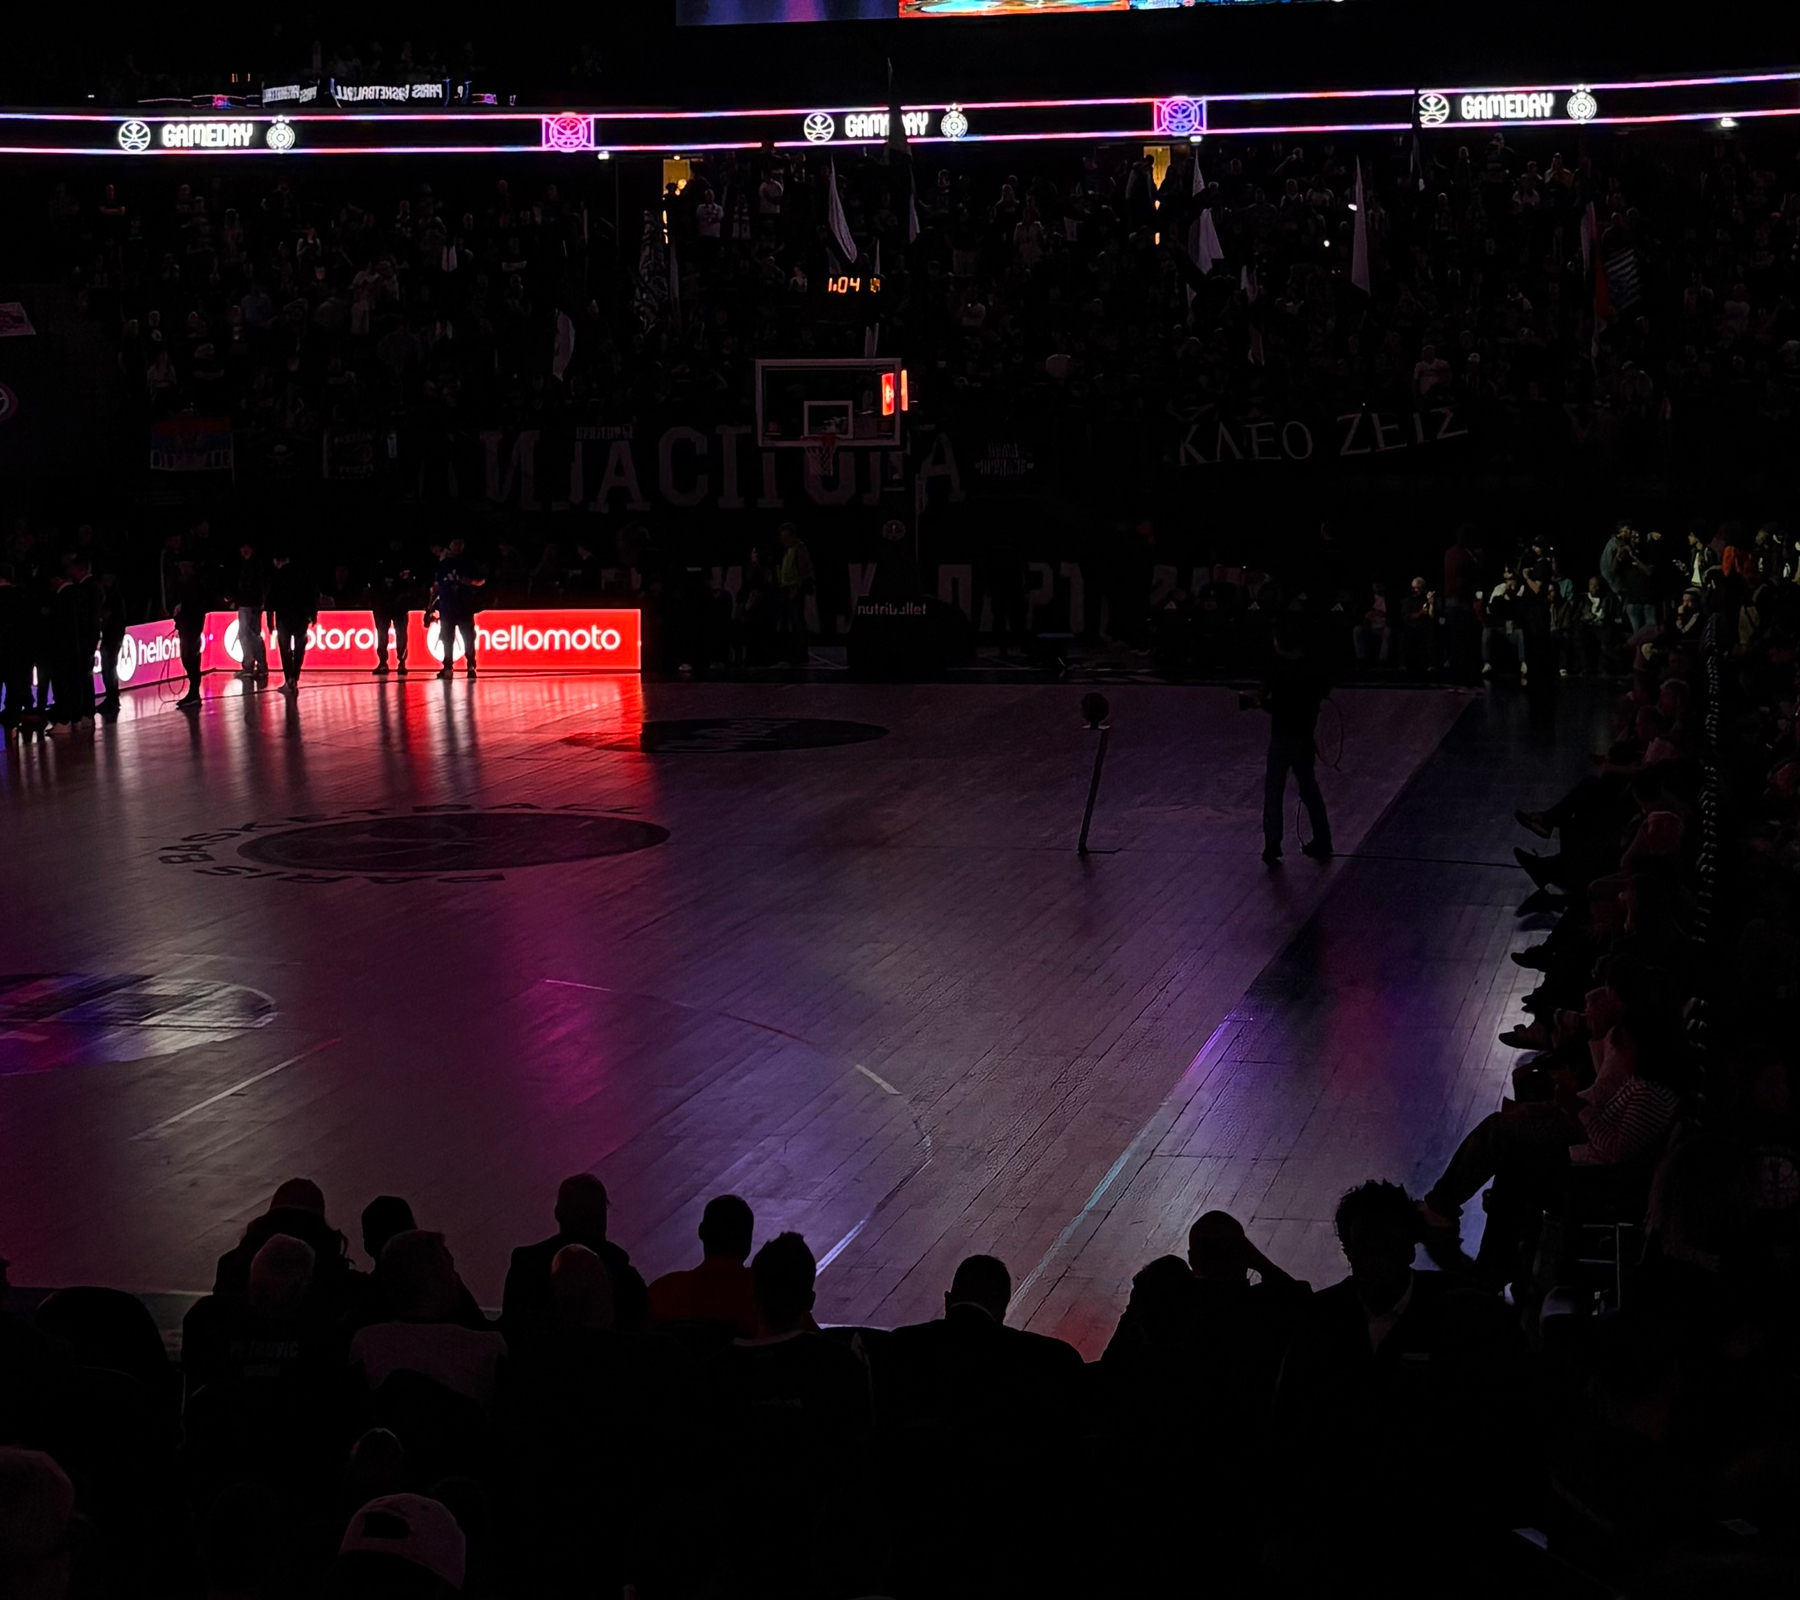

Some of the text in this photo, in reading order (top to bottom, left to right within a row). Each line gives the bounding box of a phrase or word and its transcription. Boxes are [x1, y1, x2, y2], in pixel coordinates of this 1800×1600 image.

[1461, 92, 1554, 119] GAMEDAY
[162, 123, 254, 147] GAMEDAY
[475, 624, 621, 651] hellomoto
